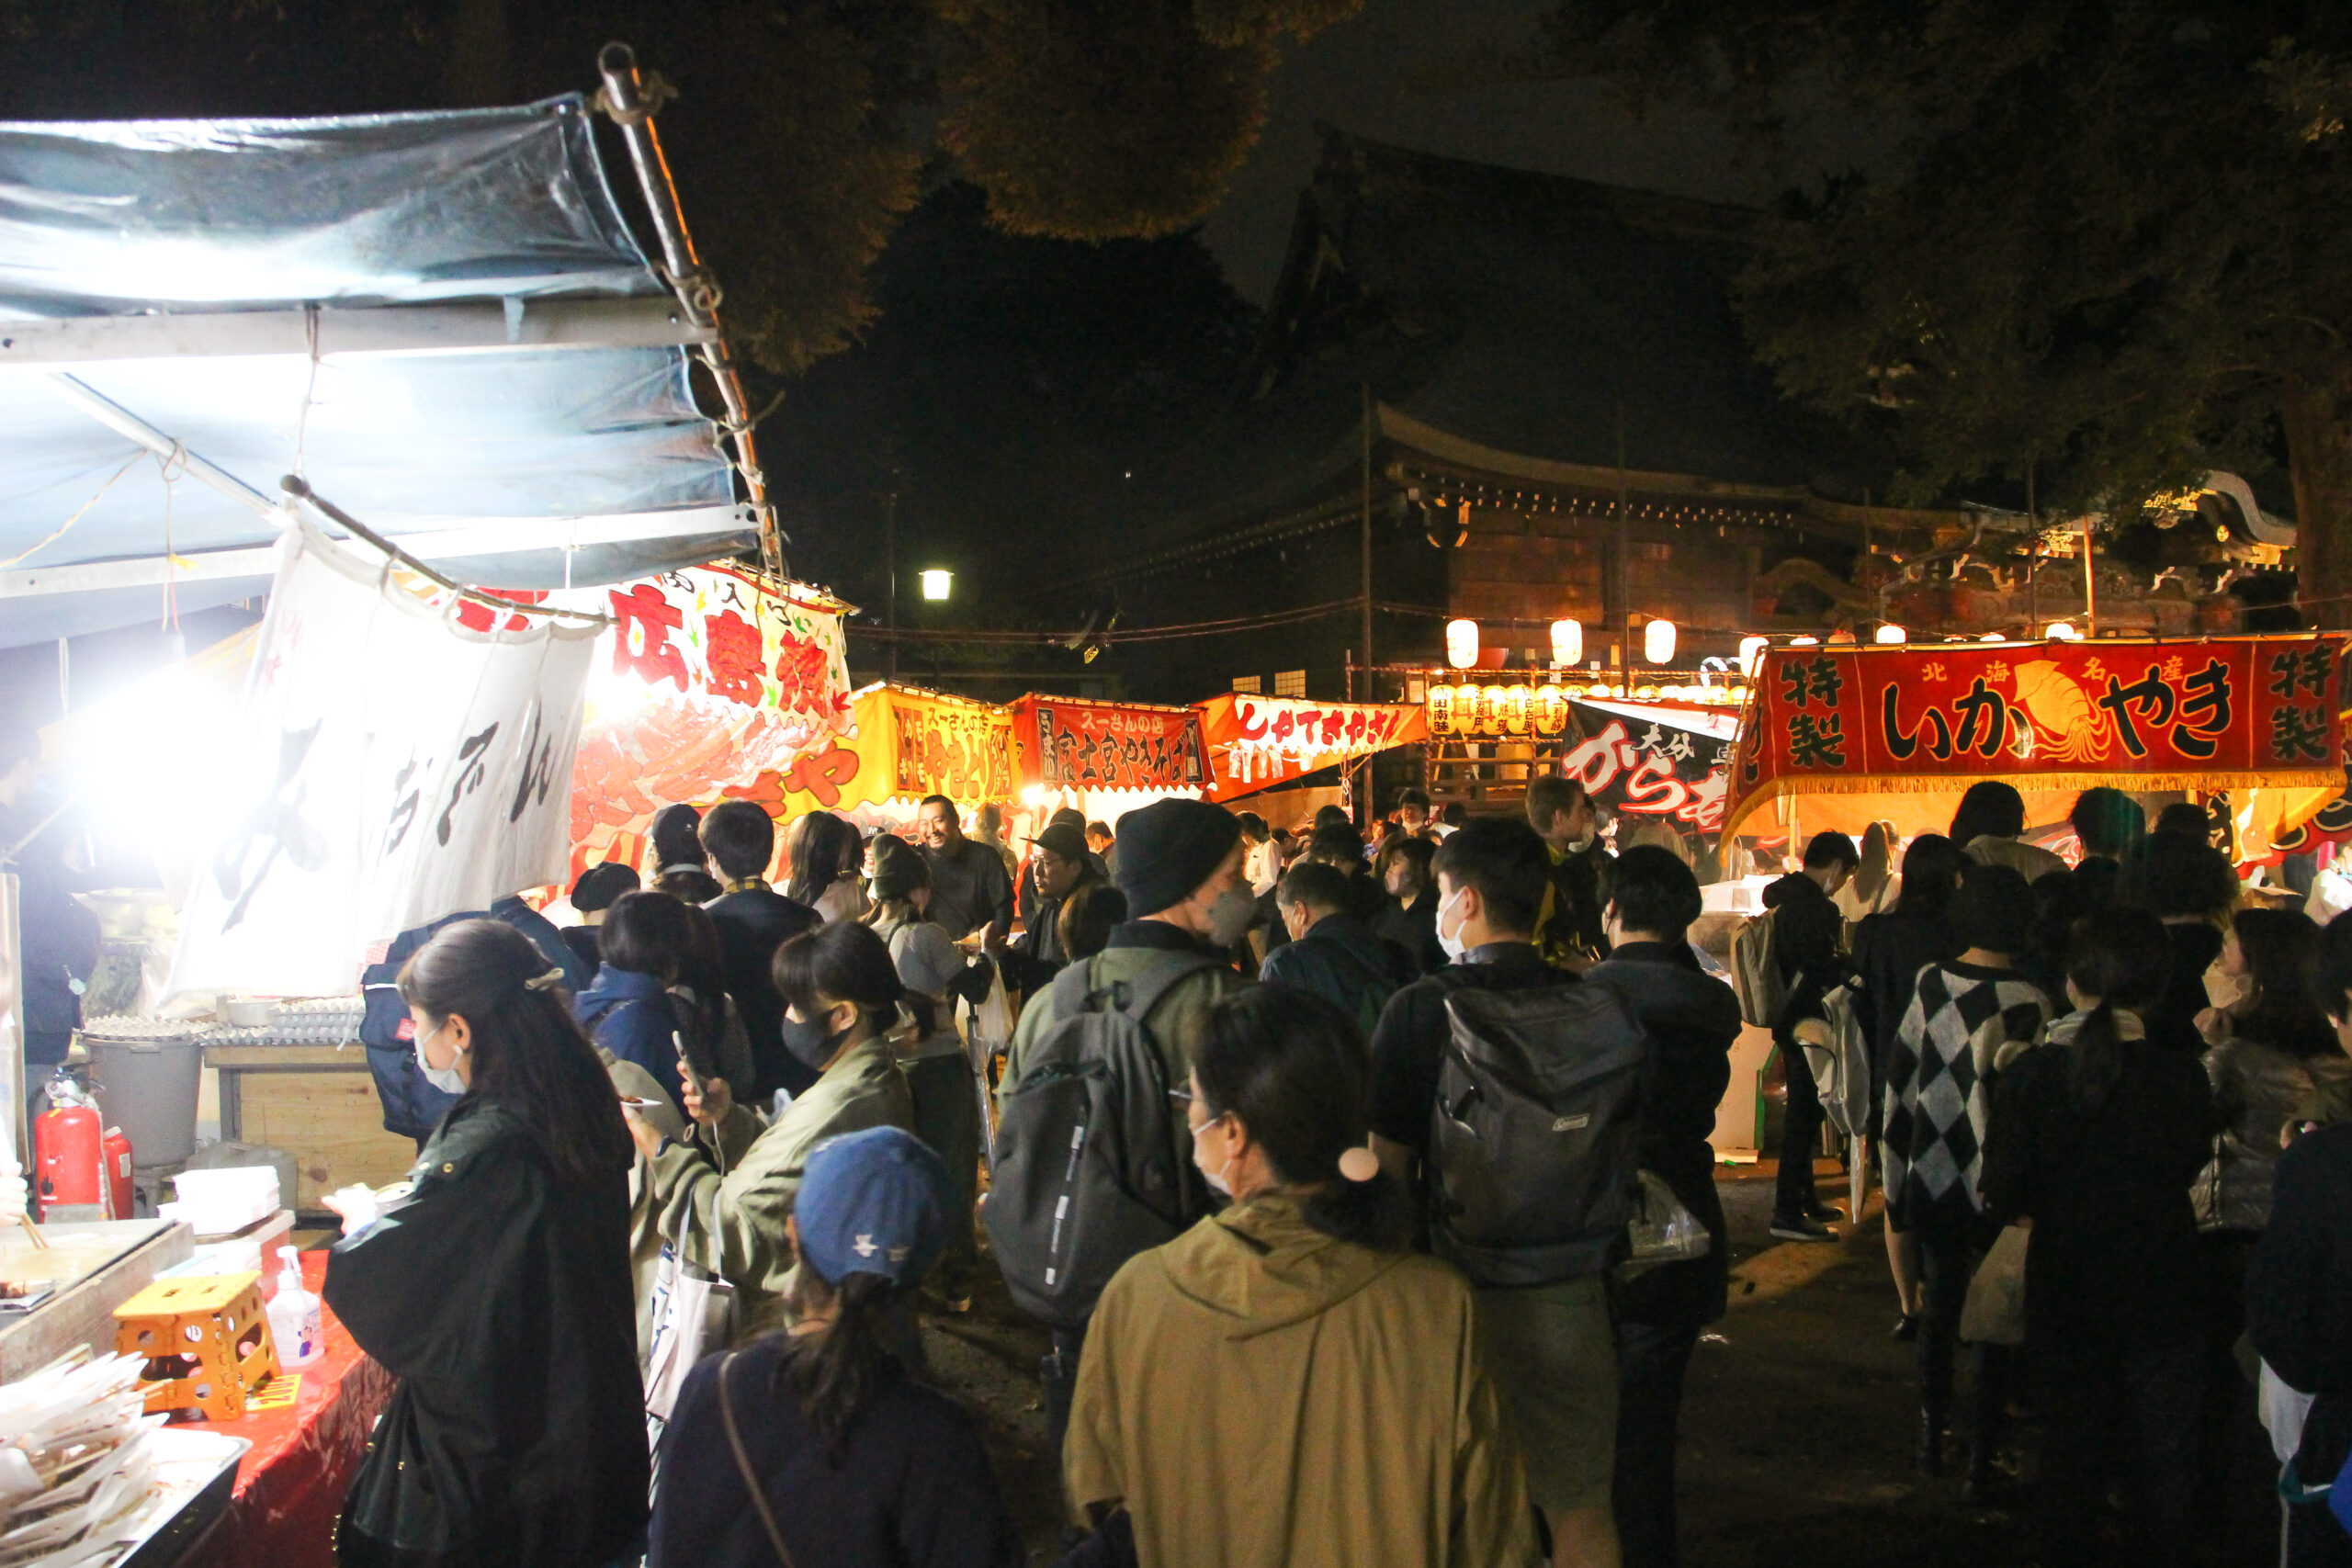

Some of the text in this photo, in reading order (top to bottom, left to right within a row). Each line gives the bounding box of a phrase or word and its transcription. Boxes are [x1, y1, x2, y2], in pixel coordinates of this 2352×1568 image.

[1922, 656, 2184, 683] 北海名産
[2269, 644, 2336, 761] 特製
[1080, 710, 1164, 736] スーさんの店
[1780, 656, 1847, 767] 特製
